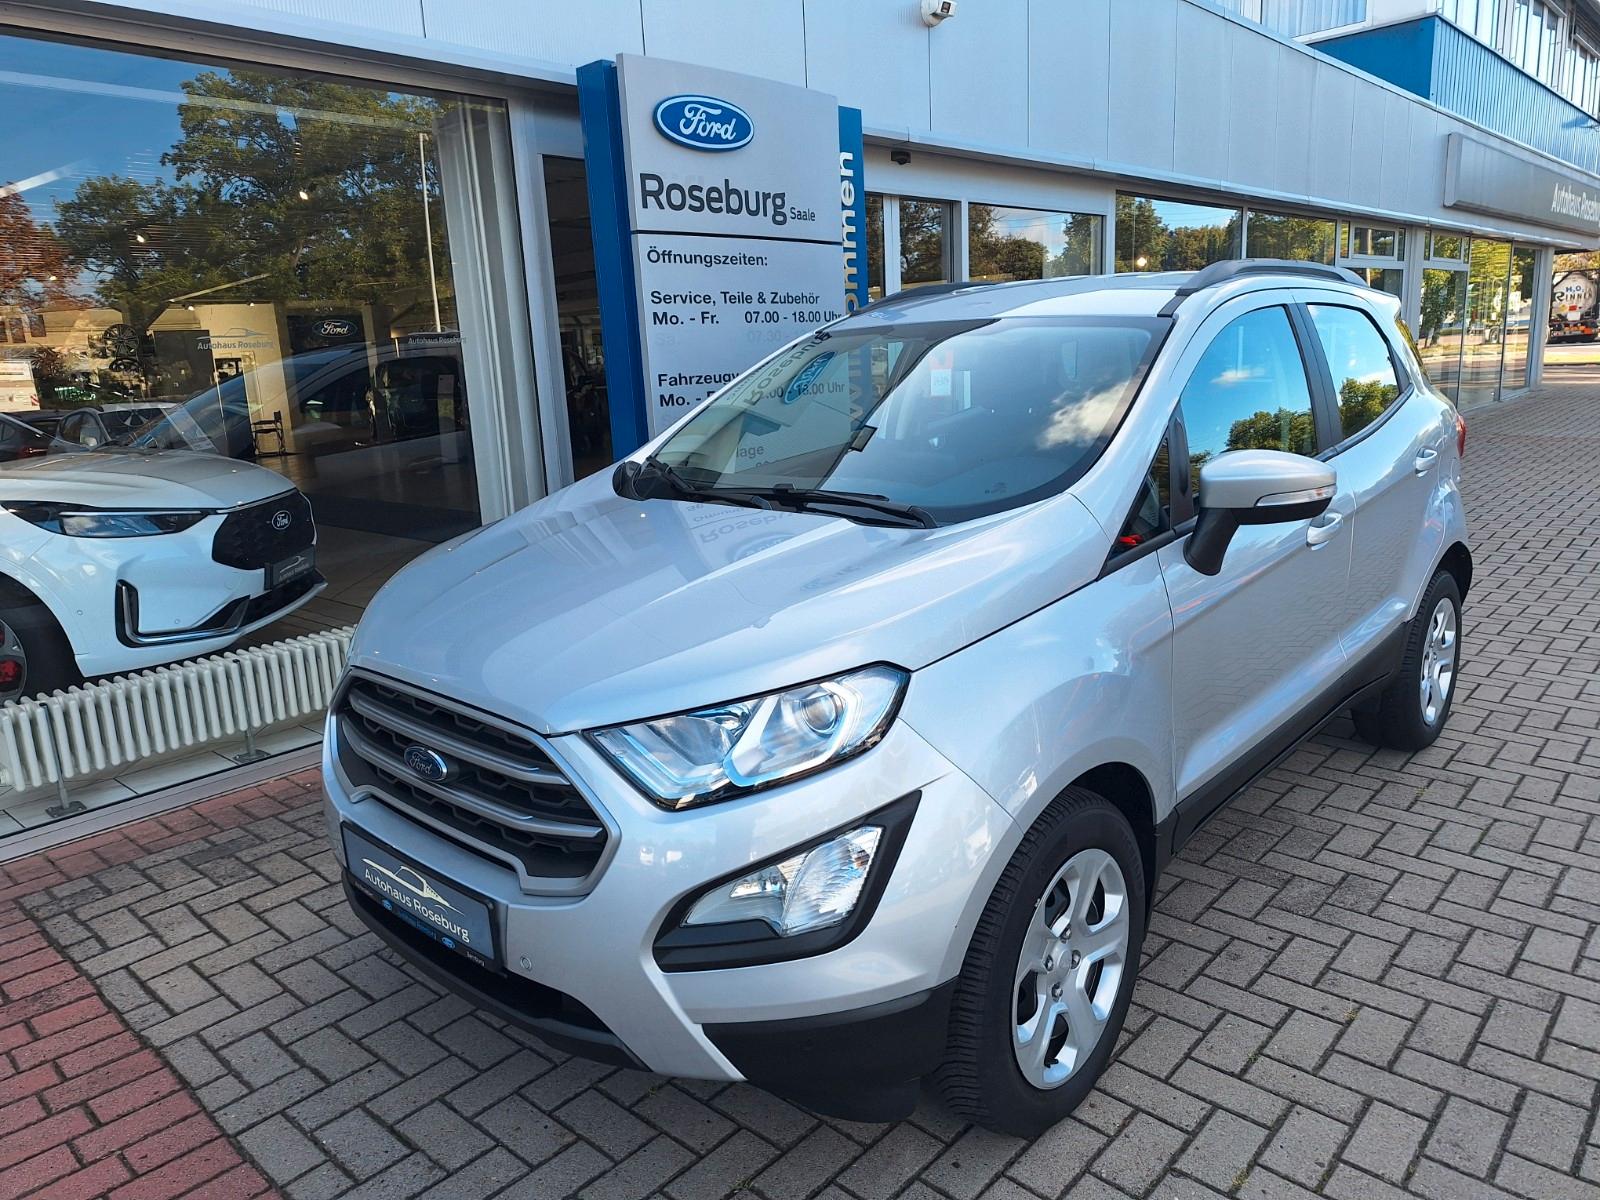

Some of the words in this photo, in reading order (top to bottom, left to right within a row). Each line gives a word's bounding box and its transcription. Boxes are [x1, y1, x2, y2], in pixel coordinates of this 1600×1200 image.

[679, 103, 737, 141] Ford
[639, 172, 788, 226] Roseburg
[789, 206, 816, 222] Saale
[647, 246, 768, 268] Öffnungszeiten:
[650, 290, 716, 306] Service,
[720, 291, 753, 304] Teile
[757, 291, 767, 304] &
[770, 292, 820, 304] Zubehör
[321, 321, 349, 334] Ford
[652, 311, 684, 325] Mo.
[700, 311, 719, 324] Fr.
[744, 311, 780, 324] 07.00
[792, 311, 821, 323] 18.00
[824, 311, 842, 322] Uhr
[197, 342, 237, 350] Autohaus
[660, 394, 690, 407] Mo.
[827, 381, 845, 393] Uhr
[410, 751, 433, 774] Ford
[365, 868, 412, 908] Autohaus
[413, 898, 470, 943] Roseburg
